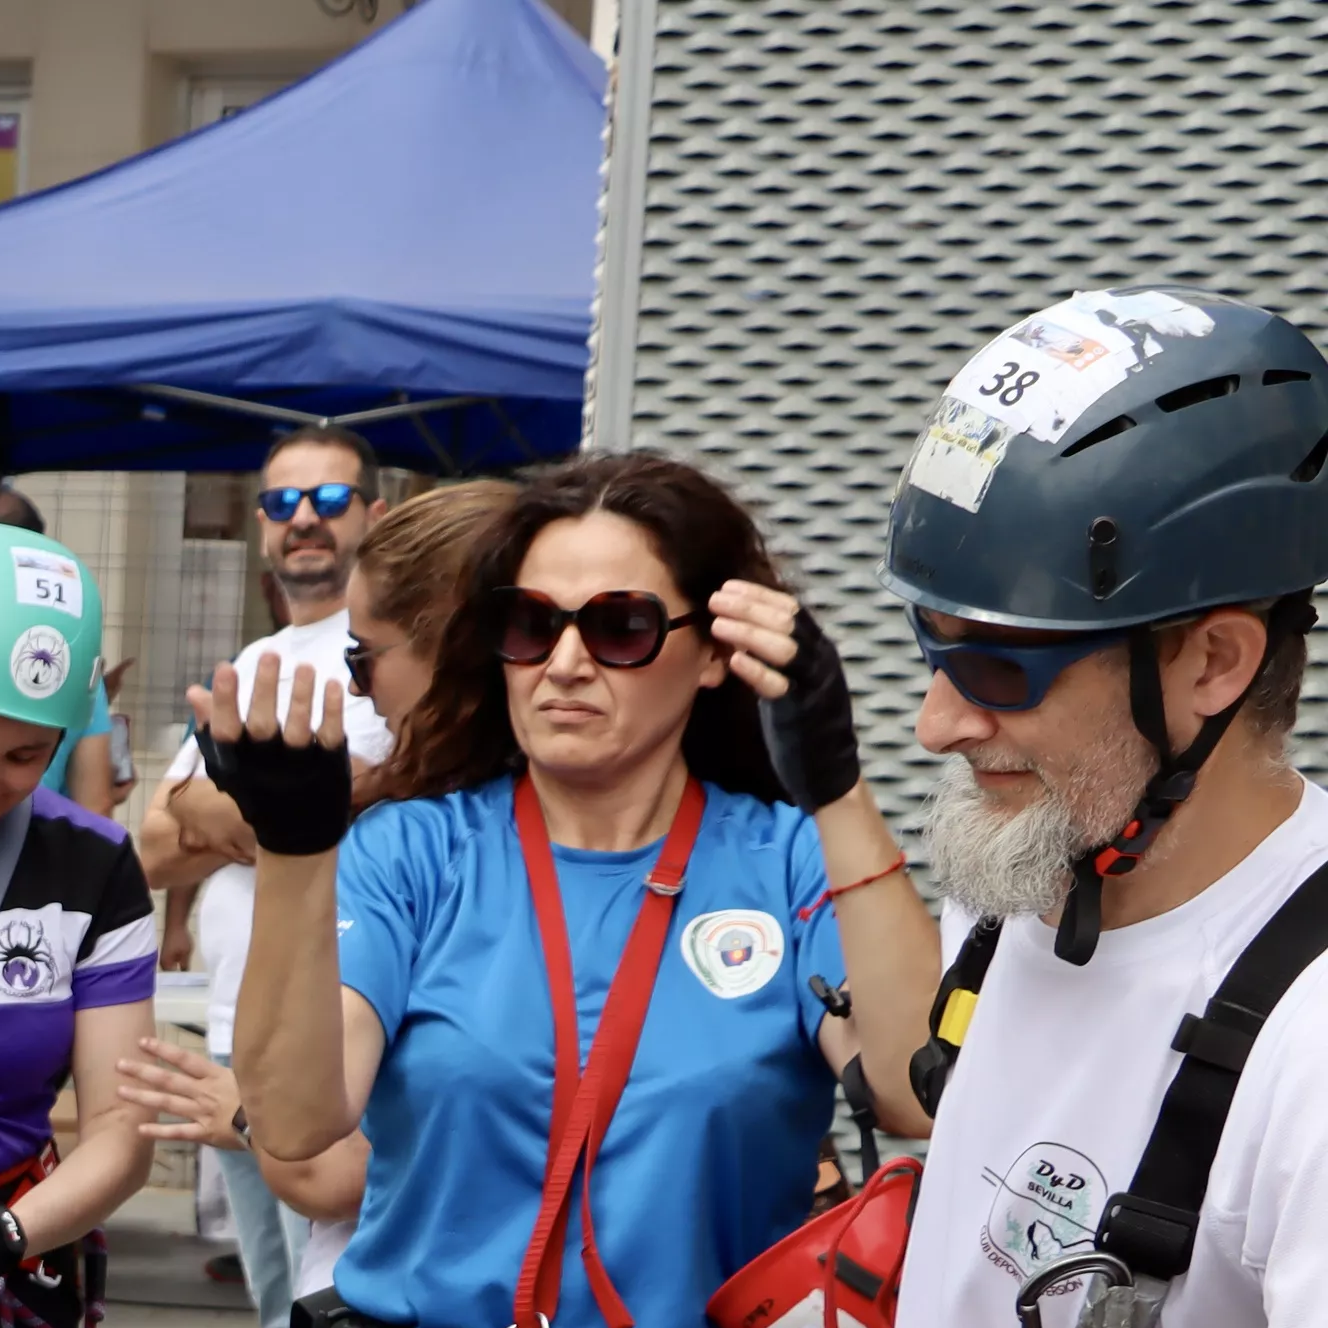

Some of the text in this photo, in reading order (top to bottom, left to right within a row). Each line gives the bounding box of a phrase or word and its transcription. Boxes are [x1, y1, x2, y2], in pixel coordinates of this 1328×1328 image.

[979, 361, 1040, 406] 38
[35, 578, 67, 604] 51
[1036, 1159, 1086, 1191] DyD
[1028, 1181, 1074, 1210] SEVILLA
